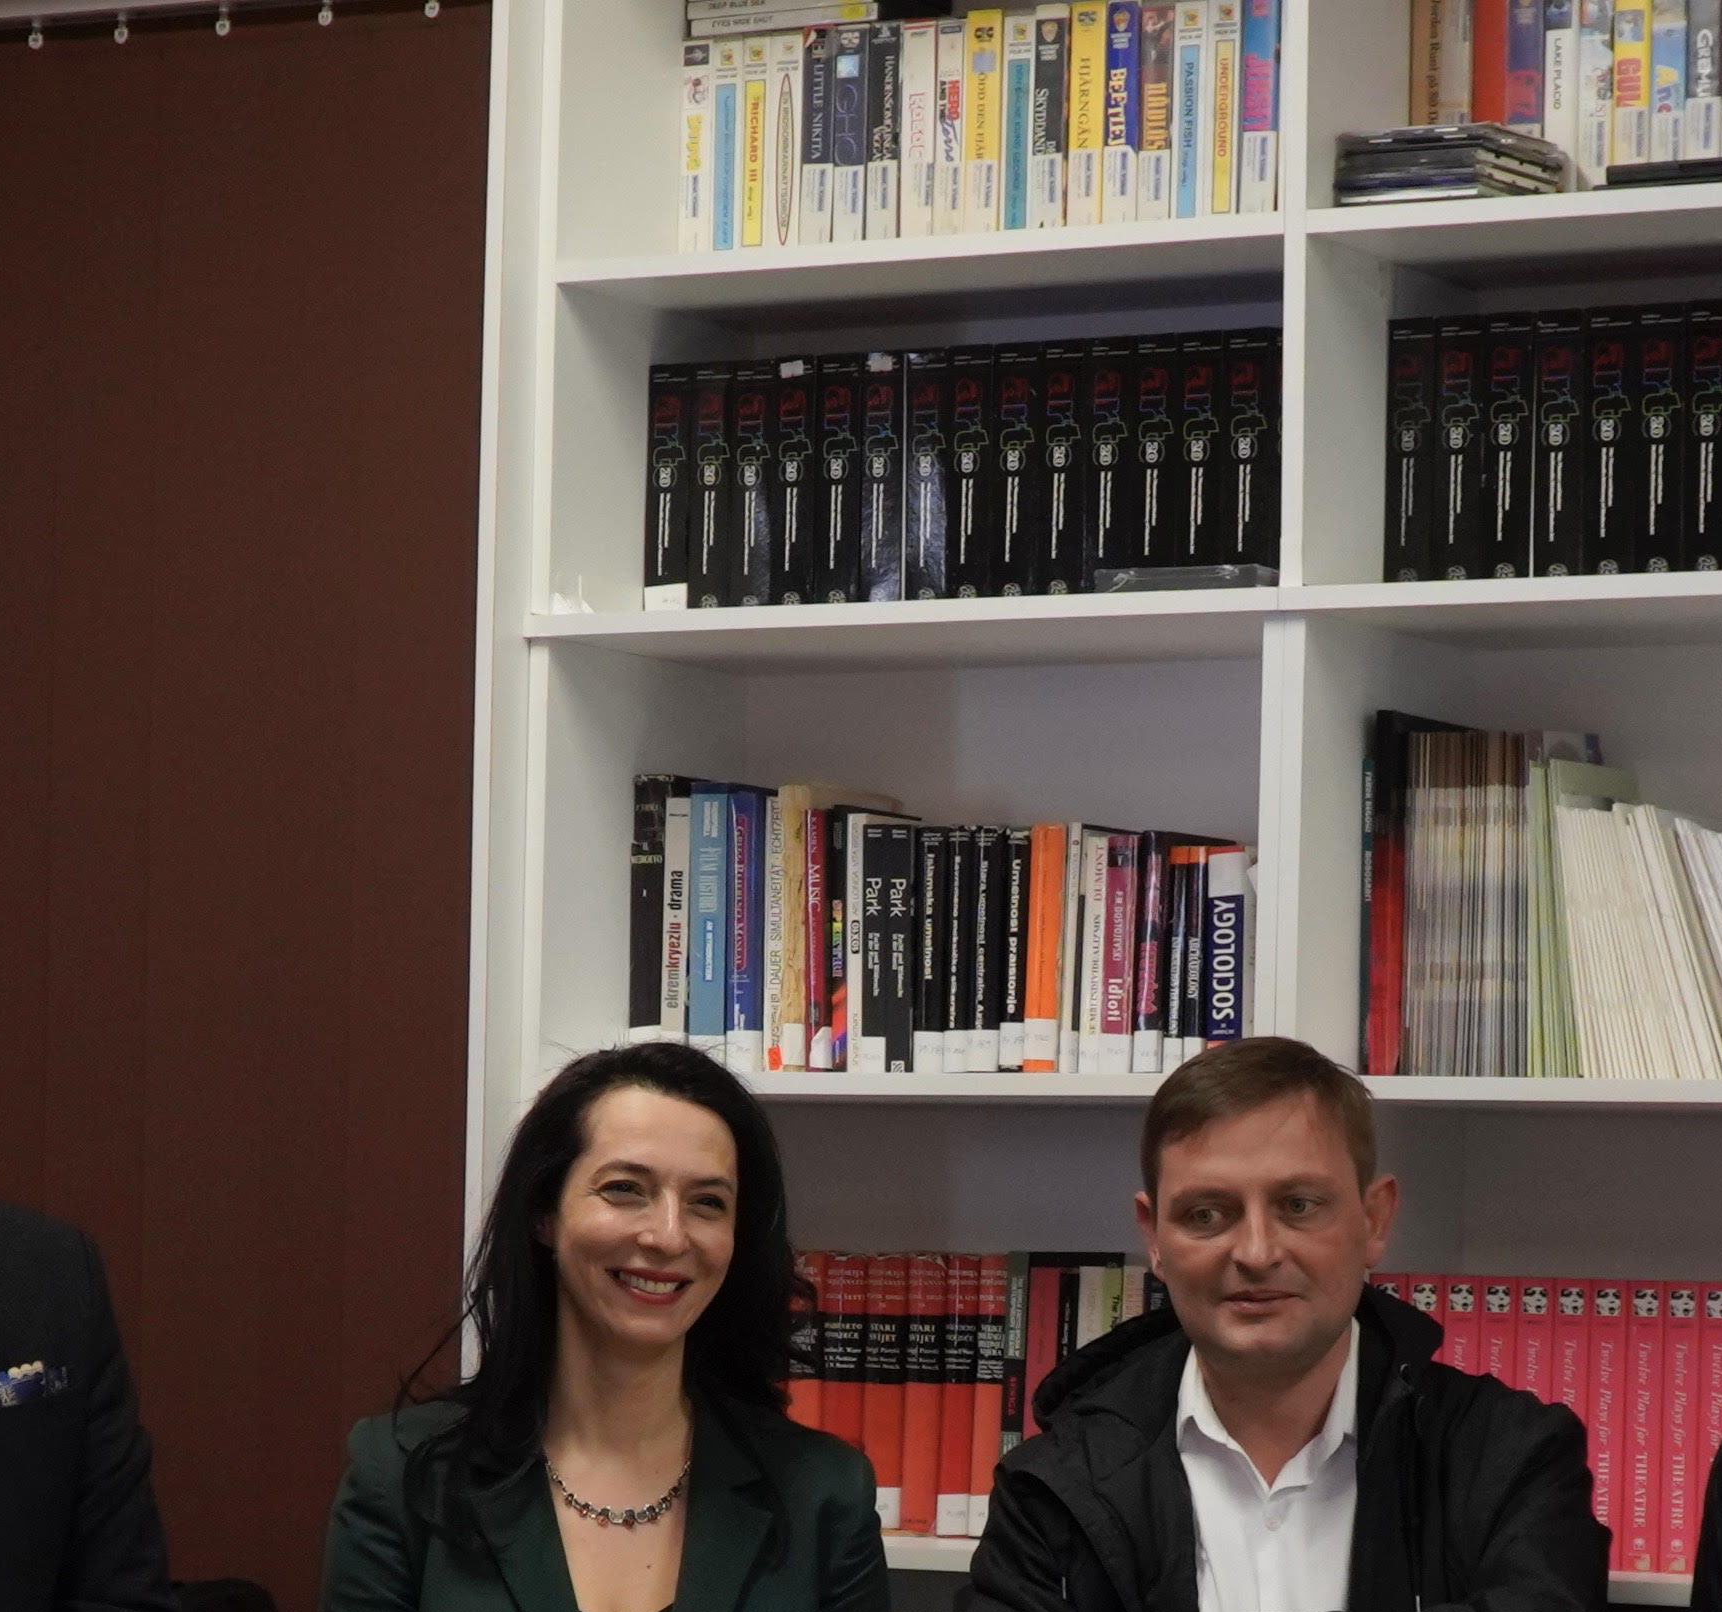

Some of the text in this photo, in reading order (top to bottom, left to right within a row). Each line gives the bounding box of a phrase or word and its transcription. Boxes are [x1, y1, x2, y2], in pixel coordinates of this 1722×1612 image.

[811, 64, 825, 159] LITTLE NIKITA
[948, 80, 960, 121] HERO
[976, 104, 985, 129] DEN
[1183, 62, 1193, 148] PASSION FISH
[1217, 58, 1228, 158] UNDERGROUND
[1448, 424, 1464, 450] 20
[1497, 421, 1513, 446] 20
[1599, 417, 1615, 442] 20
[1698, 412, 1715, 437] 20
[871, 454, 884, 478] 20
[961, 449, 974, 474] 20
[1006, 447, 1021, 472] 20
[1099, 442, 1113, 467] 20
[1189, 439, 1205, 462] 20
[743, 464, 756, 487] 20
[784, 459, 799, 482] 20
[698, 847, 722, 871] FILM
[1094, 845, 1103, 901] DUMONT
[698, 876, 719, 913] HISTORY
[808, 863, 821, 913] MUSIC
[865, 877, 882, 916] Park
[889, 878, 907, 918] Park
[924, 854, 936, 980] Islamska umetnost
[1006, 859, 1022, 1014] Umetnost praistorije
[665, 870, 684, 1008] ekremkryeziu drama
[770, 950, 782, 985] DAUER
[1212, 899, 1235, 1020] SOCIOLOGY
[1106, 979, 1123, 1021] Idioti
[1112, 1295, 1120, 1313] The
[1490, 1337, 1503, 1377] Twelv
[1526, 1339, 1540, 1382] Twelve
[1563, 1339, 1577, 1382] Twelve
[1599, 1340, 1613, 1383] Twelve
[1597, 1388, 1612, 1421] Plays
[1597, 1423, 1612, 1446] for
[1633, 1341, 1651, 1528] Twelve Plays for THEATRE
[1671, 1342, 1687, 1529] Twelve Plays for THEATRE
